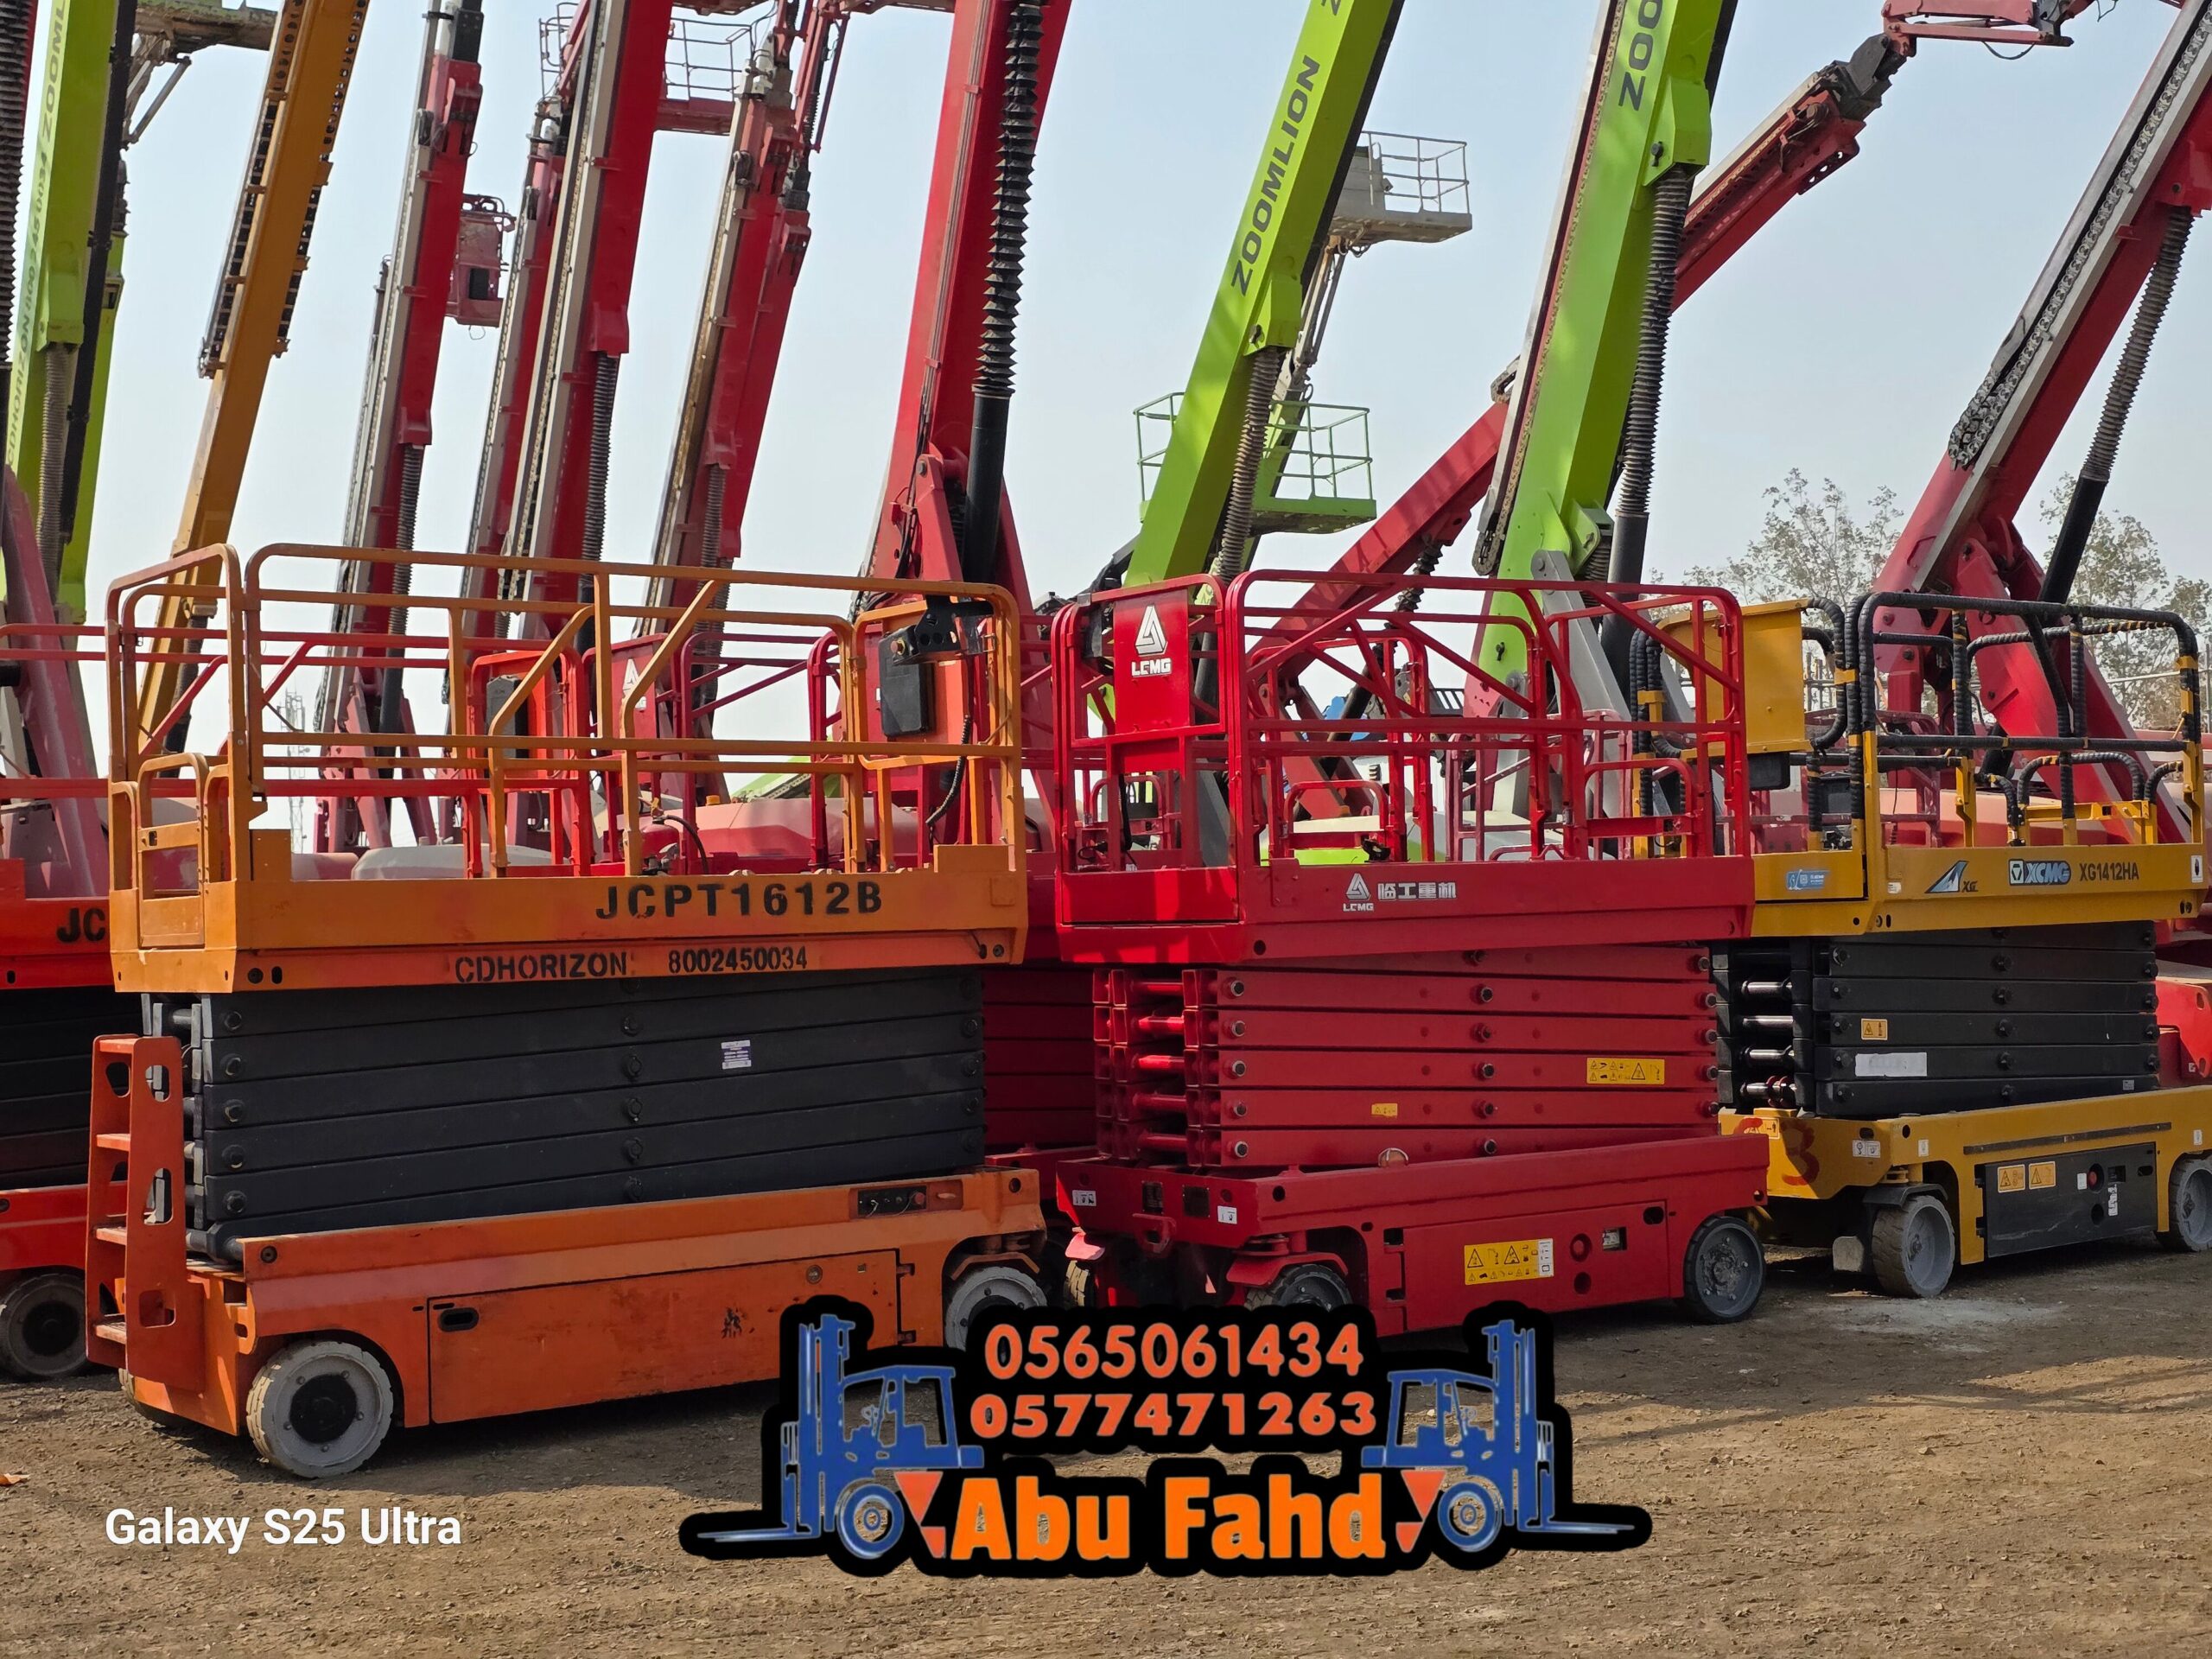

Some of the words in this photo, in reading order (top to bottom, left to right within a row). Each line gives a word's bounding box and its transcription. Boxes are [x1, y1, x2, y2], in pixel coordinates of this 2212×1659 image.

[1231, 54, 1320, 296] ZOOMLION
[1131, 658, 1172, 677] LCMG
[2024, 862, 2071, 884] XCMG
[2080, 862, 2139, 881] XG1412HA
[595, 880, 882, 920] JCPT1612B
[1377, 881, 1457, 900] 临工重机
[1343, 903, 1374, 912] LCMG
[454, 952, 627, 982] CDHORIZON
[668, 946, 808, 973] 8002450034
